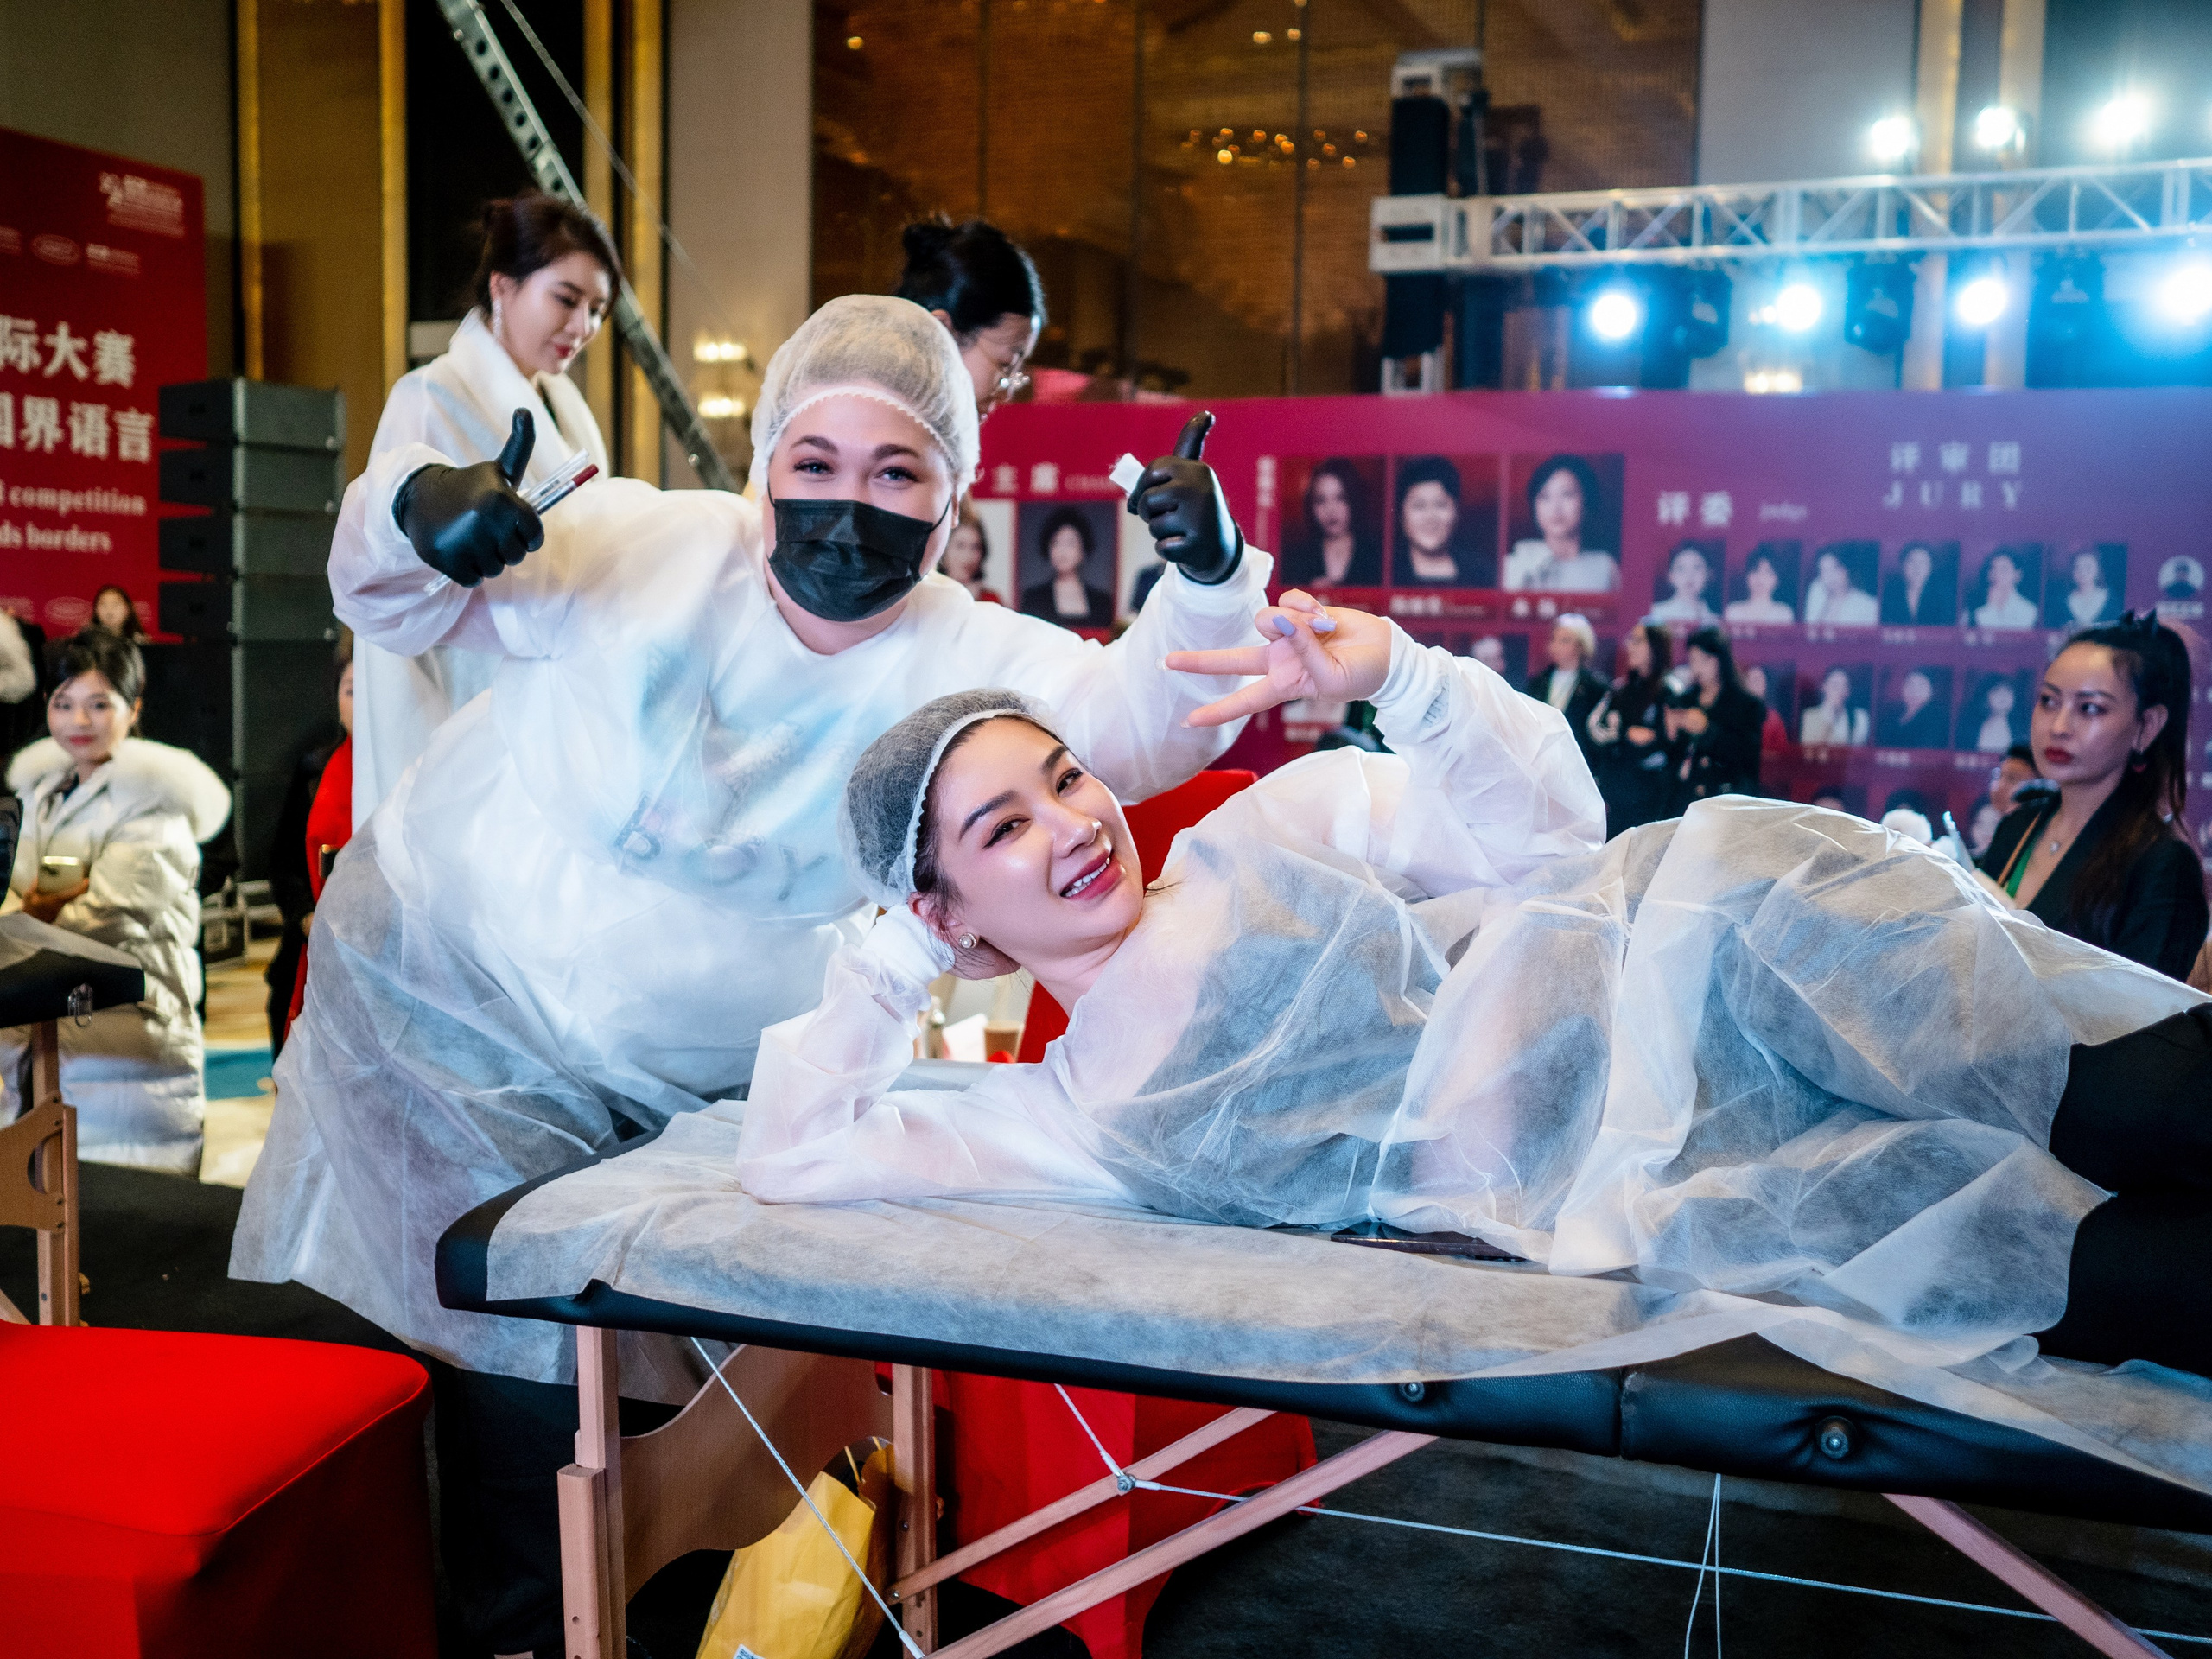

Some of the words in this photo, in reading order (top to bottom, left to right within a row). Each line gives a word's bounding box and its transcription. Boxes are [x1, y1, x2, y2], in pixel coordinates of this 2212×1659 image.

[9, 486, 147, 517] competition
[1883, 480, 2023, 509] JURY
[25, 521, 112, 553] borders
